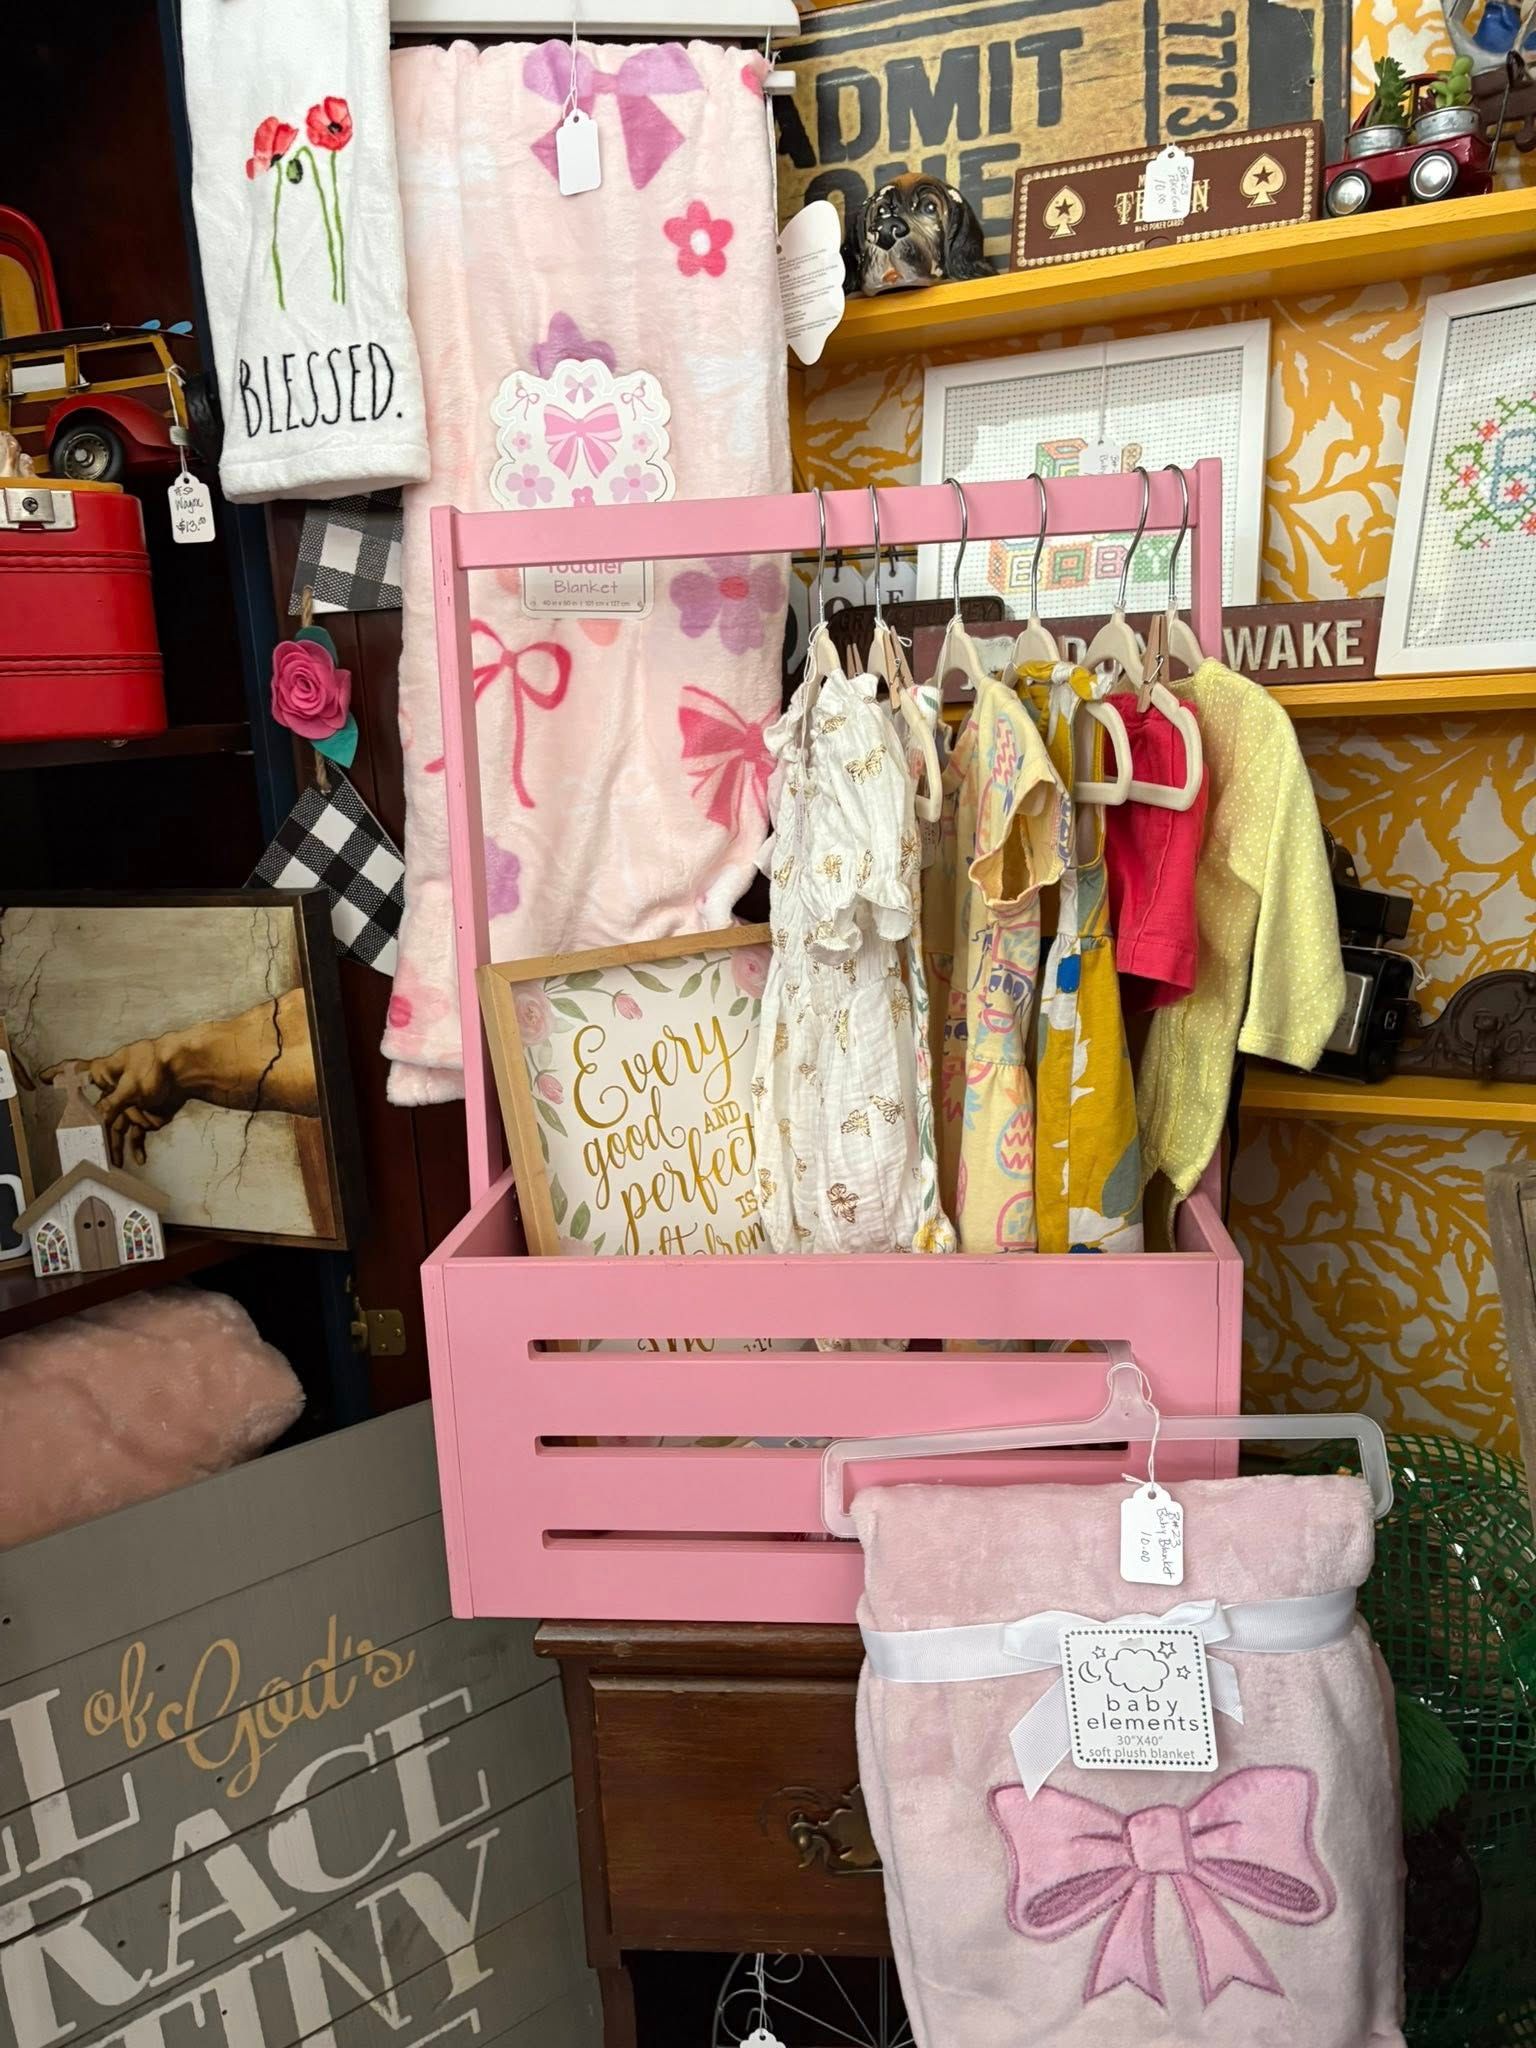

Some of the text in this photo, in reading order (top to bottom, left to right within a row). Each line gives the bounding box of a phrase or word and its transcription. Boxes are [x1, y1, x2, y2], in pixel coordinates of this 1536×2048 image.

[1165, 10, 1238, 136] 7773
[804, 143, 1021, 250] OE
[240, 342, 402, 438] BLESSED.
[554, 580, 619, 594] Blanket
[1222, 619, 1365, 672] WAKE
[573, 1016, 749, 1129] Every
[583, 1086, 741, 1210] good AND
[621, 1112, 756, 1255] perfect
[84, 1614, 416, 1798] of God's
[1087, 1712, 1199, 1732] elements
[1089, 1747, 1196, 1761] soft plush blanket
[1106, 1693, 1178, 1717] baby
